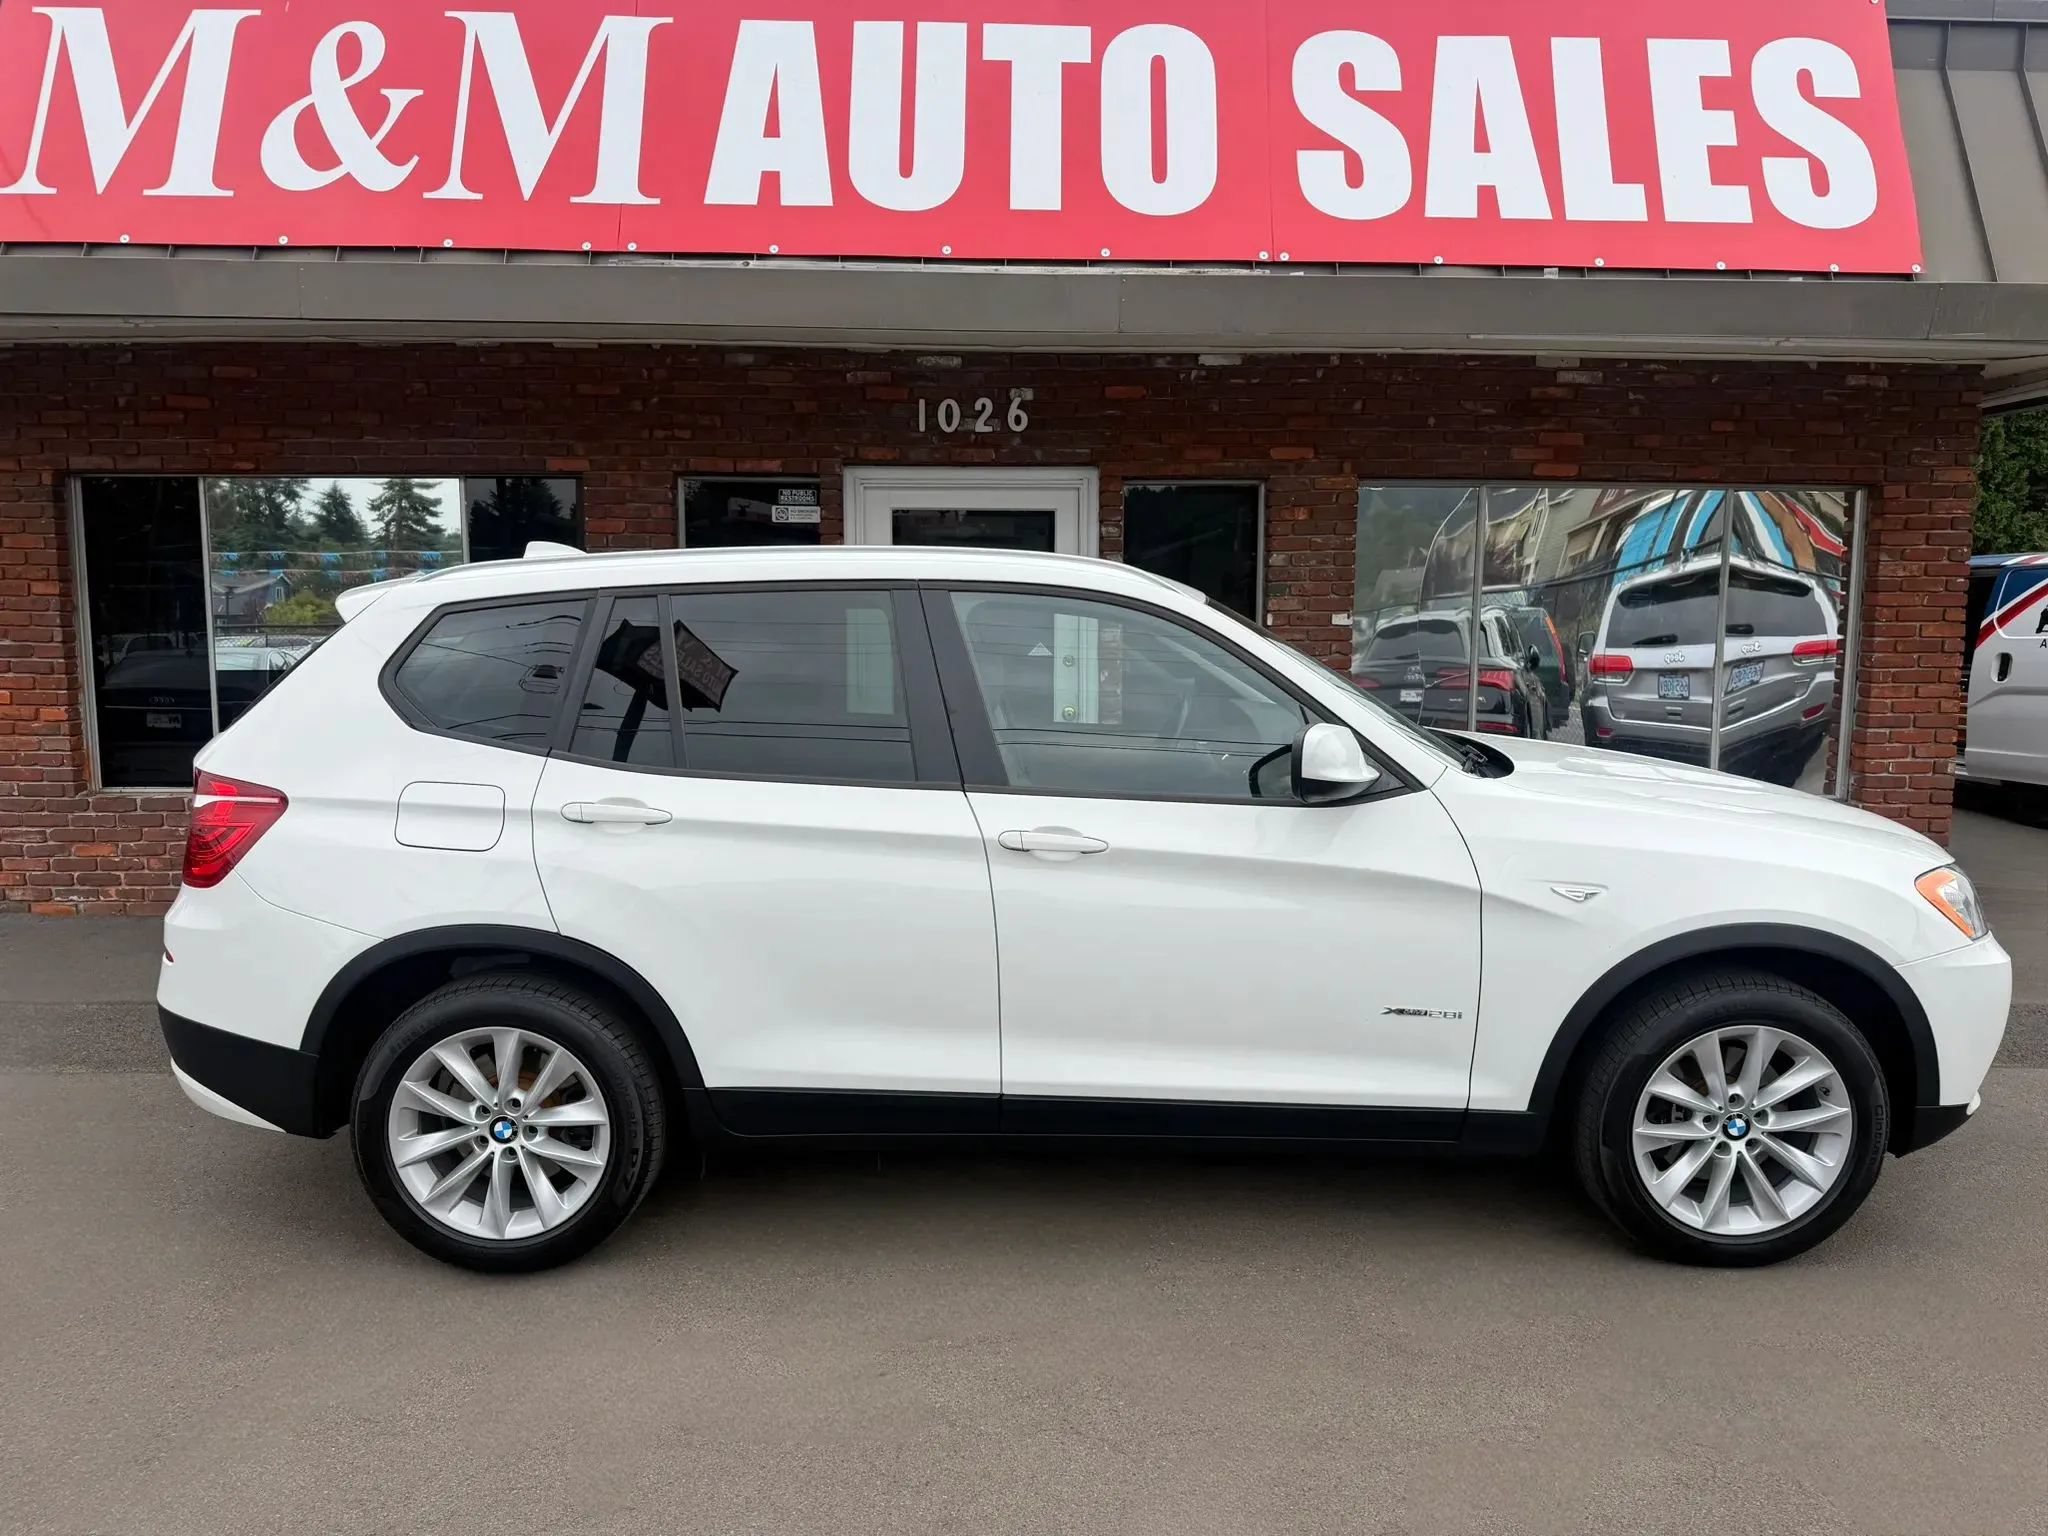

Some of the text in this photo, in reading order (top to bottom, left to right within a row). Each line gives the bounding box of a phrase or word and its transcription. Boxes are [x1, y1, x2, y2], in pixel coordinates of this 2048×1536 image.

[704, 19, 1217, 216] AUTO
[1291, 30, 1878, 229] SALES
[918, 397, 1029, 433] 1026
